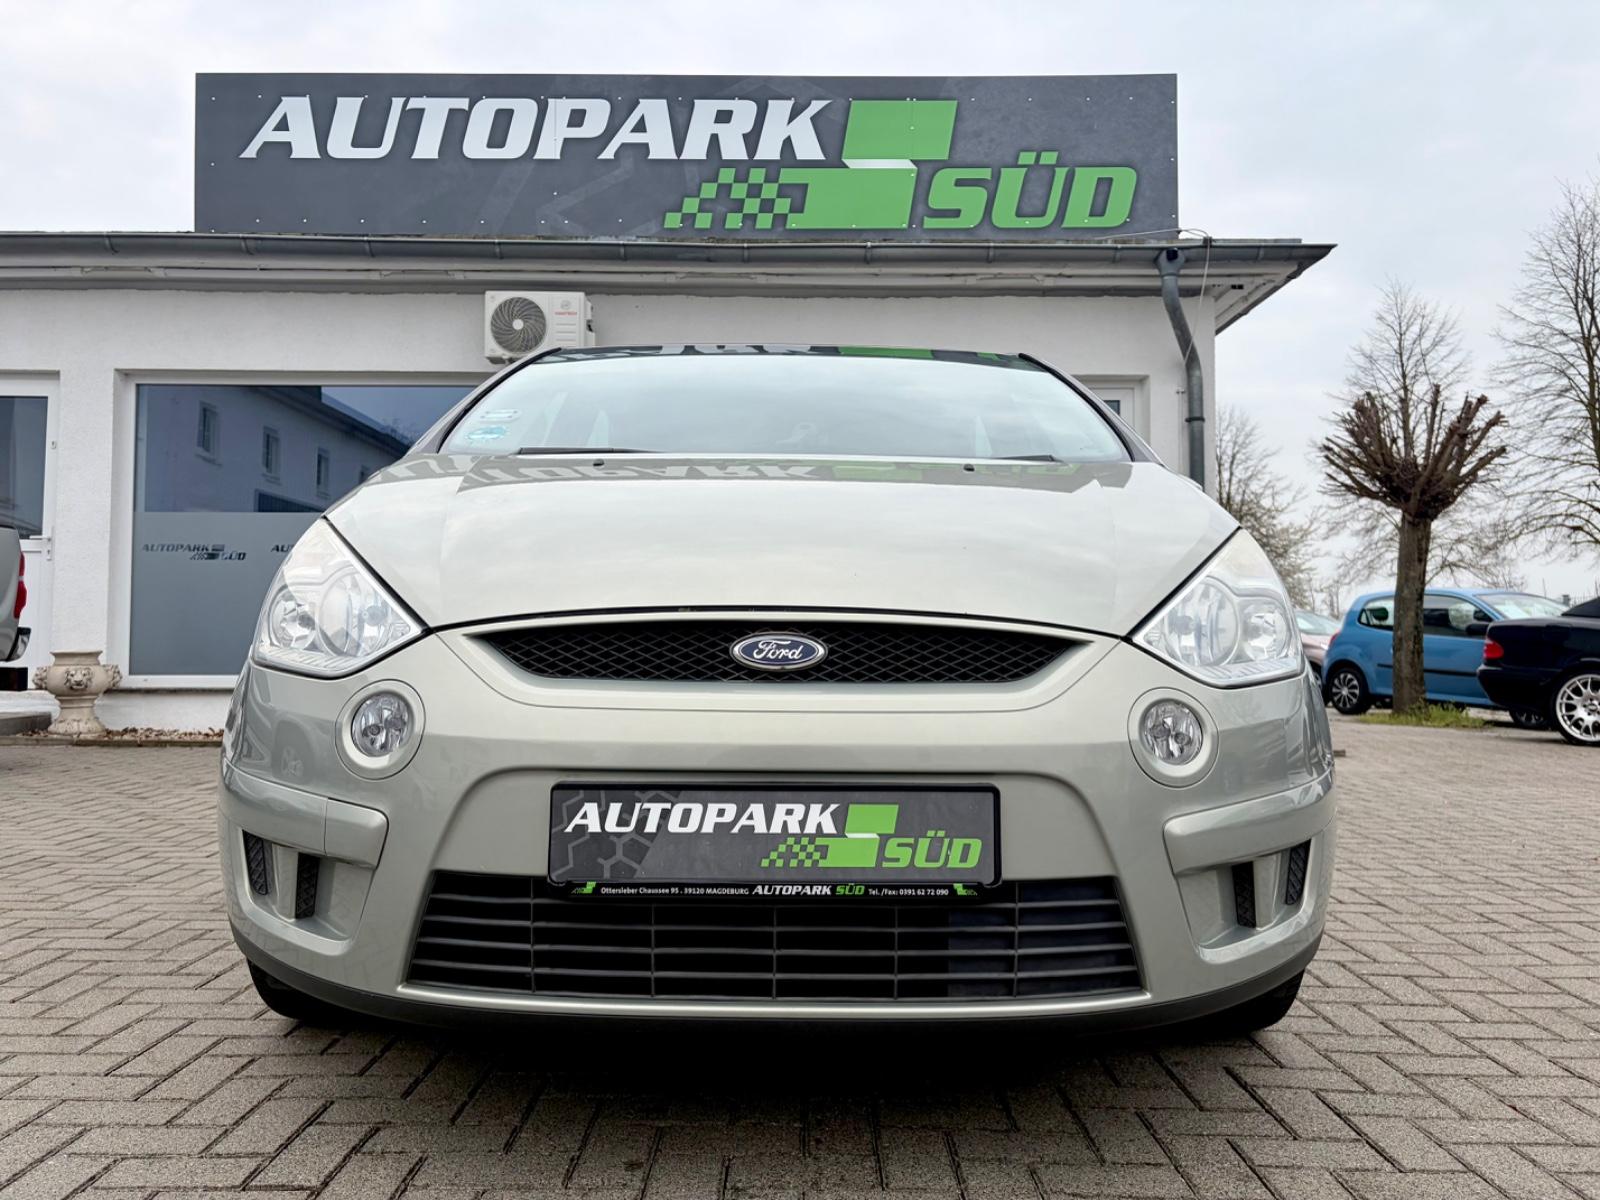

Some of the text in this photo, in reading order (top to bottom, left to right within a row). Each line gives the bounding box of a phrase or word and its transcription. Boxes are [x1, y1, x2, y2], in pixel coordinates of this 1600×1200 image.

[241, 95, 831, 162] AUTOPARK
[922, 150, 1137, 230] SÜD
[143, 544, 210, 553] AUTOPARK
[753, 639, 804, 660] Ford
[564, 802, 840, 834] AUTOPARK
[881, 830, 983, 869] SÜD
[670, 886, 679, 895] 95
[684, 887, 705, 896] 39120
[705, 887, 750, 896] MAGDEBURG
[752, 885, 832, 897] AUTOPARK
[835, 883, 866, 898] SÜD
[899, 887, 915, 897] 0391
[916, 887, 926, 897] 62
[926, 887, 936, 897] 72
[935, 887, 950, 897] 090
